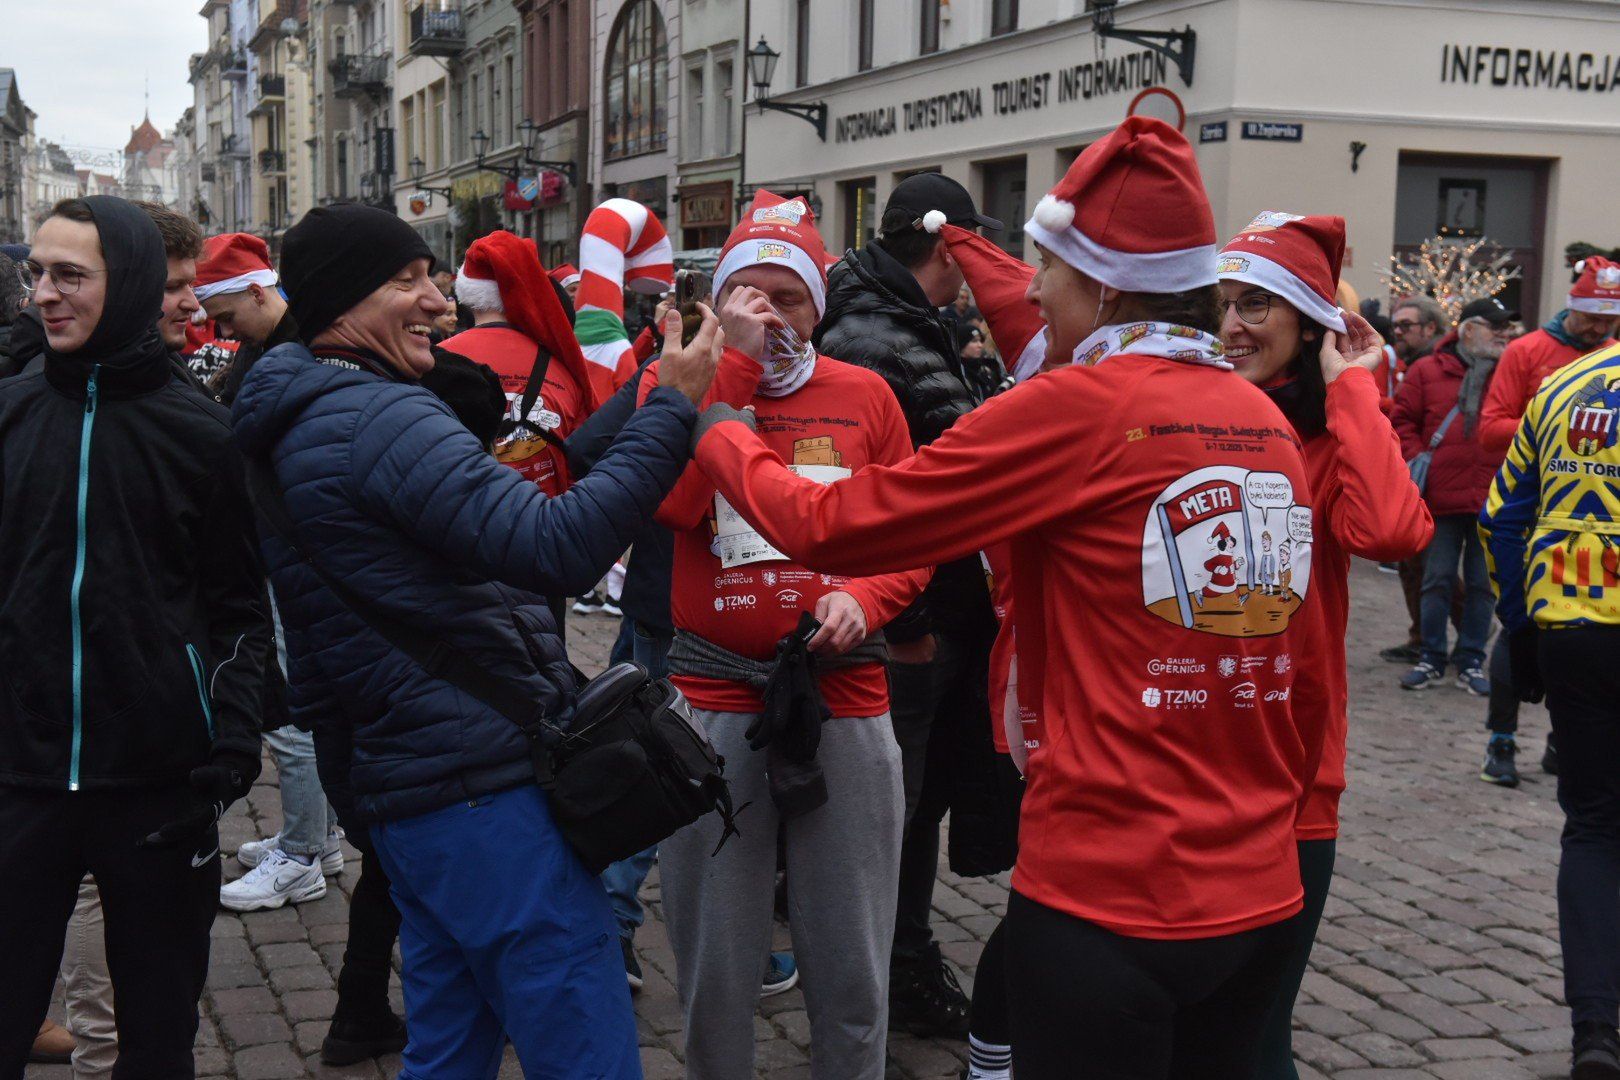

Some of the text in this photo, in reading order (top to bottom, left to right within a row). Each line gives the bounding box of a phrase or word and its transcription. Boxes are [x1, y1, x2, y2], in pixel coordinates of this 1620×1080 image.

[1441, 44, 1620, 92] INFORMACJA
[835, 49, 1167, 143] INFORMACJA TURYSTYCZNA TOURIST INFORMATION
[1126, 428, 1147, 442] 23.
[1549, 459, 1620, 477] SMS TOR
[1179, 486, 1233, 520] META
[725, 594, 757, 606] TZMO
[1147, 658, 1206, 676] COPERNICUS
[1166, 657, 1196, 665] GALERIA
[1164, 689, 1208, 703] TZMO
[1234, 690, 1255, 699] PGE
